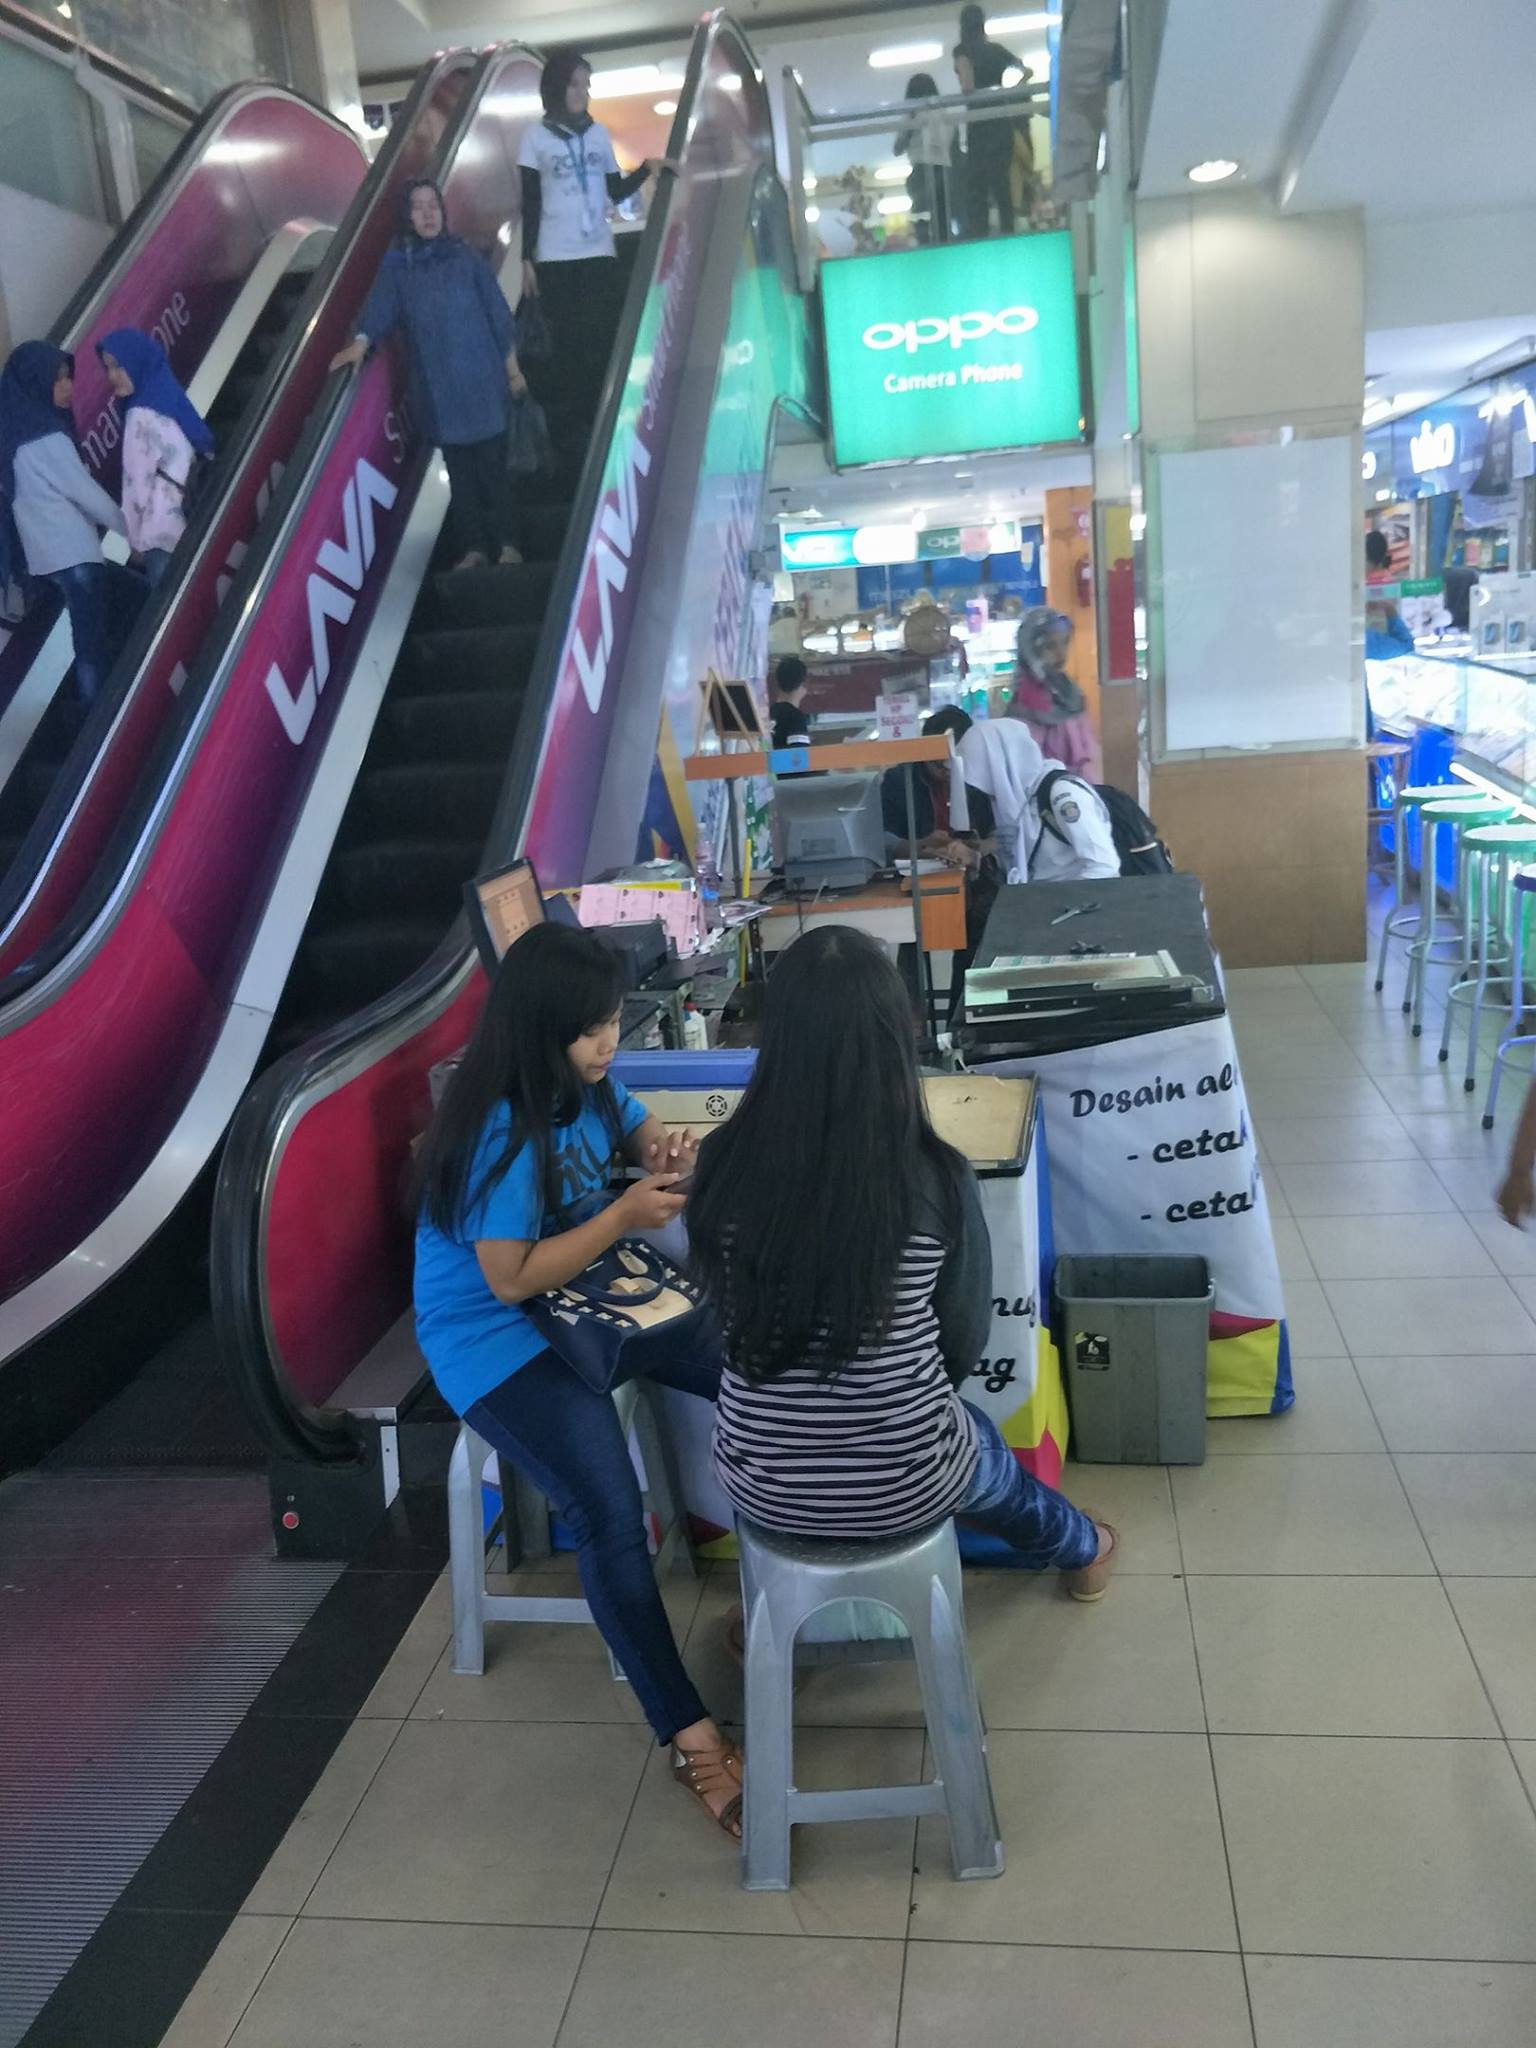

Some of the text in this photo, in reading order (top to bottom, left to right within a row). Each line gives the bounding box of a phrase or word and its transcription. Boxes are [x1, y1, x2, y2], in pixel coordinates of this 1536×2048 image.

[883, 363, 1024, 393] Camera Phone
[264, 457, 399, 745] LAVA
[1069, 1063, 1238, 1118] Desain al
[1165, 1188, 1256, 1223] ceta
